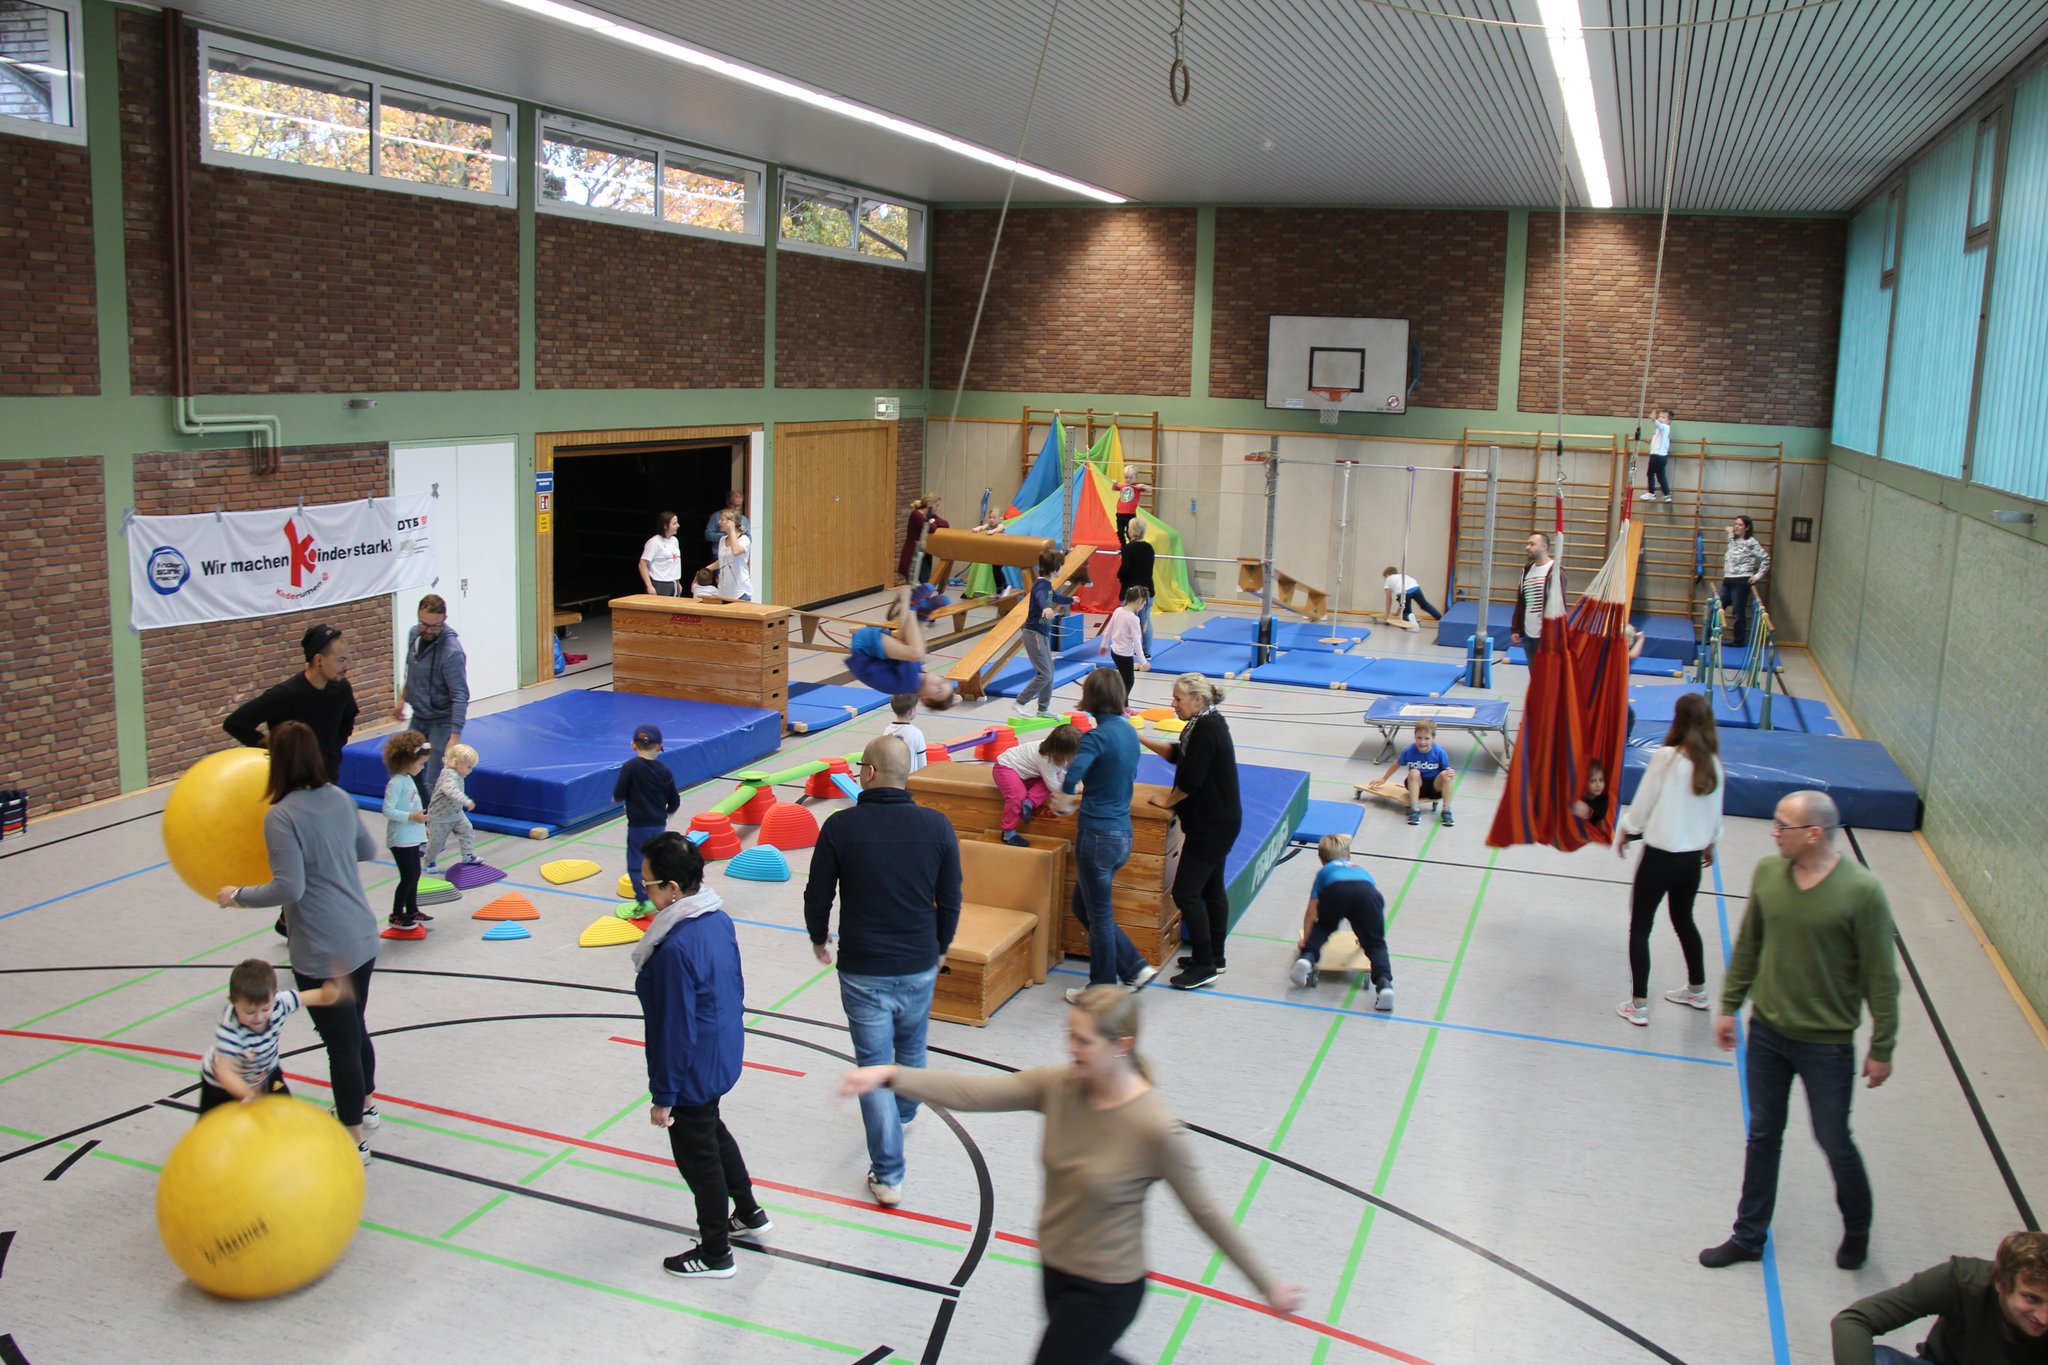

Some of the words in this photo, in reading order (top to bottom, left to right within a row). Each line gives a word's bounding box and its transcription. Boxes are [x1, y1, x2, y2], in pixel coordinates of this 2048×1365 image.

[201, 560, 227, 576] Wir
[231, 555, 289, 572] machen
[353, 538, 392, 556] stark!
